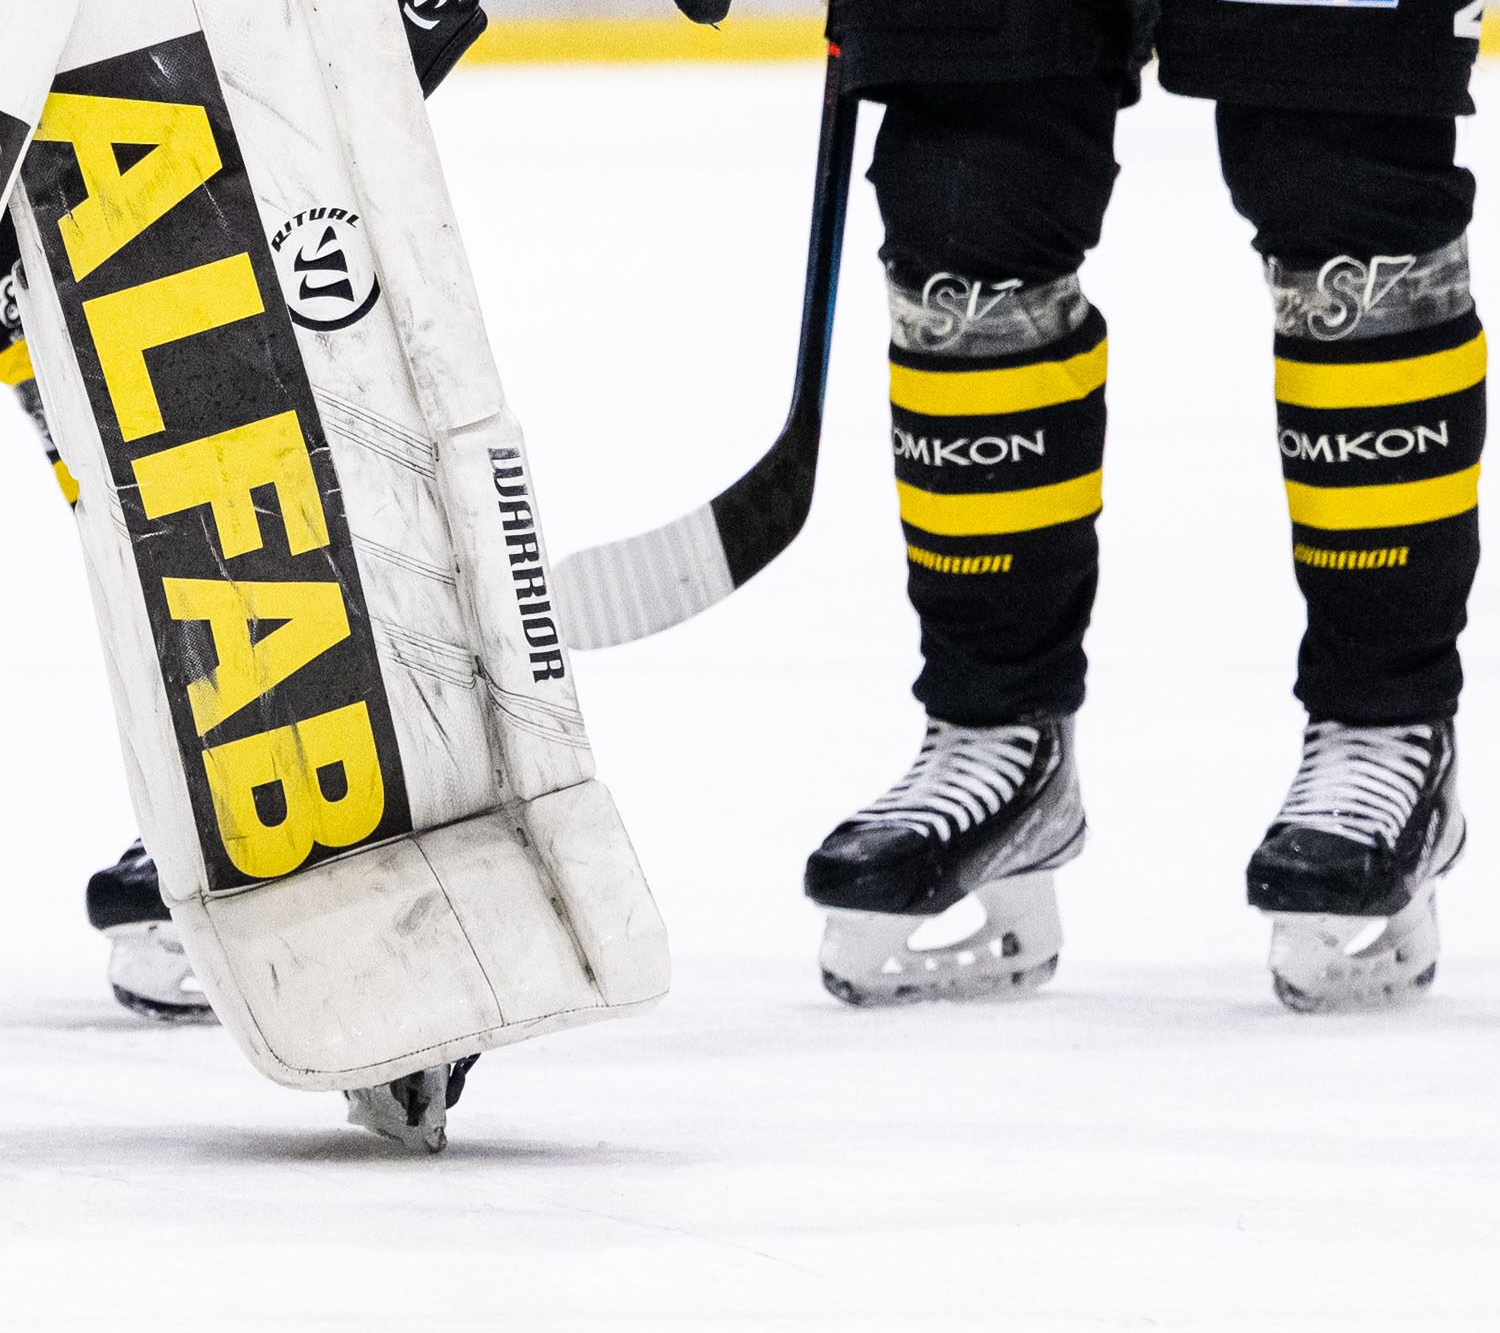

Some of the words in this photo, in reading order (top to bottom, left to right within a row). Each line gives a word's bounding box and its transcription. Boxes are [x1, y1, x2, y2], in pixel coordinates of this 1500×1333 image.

[269, 206, 361, 255] RITUAL
[32, 89, 388, 879] ALFAB
[1278, 421, 1450, 464] OMKON
[486, 446, 566, 684] WARRIOR
